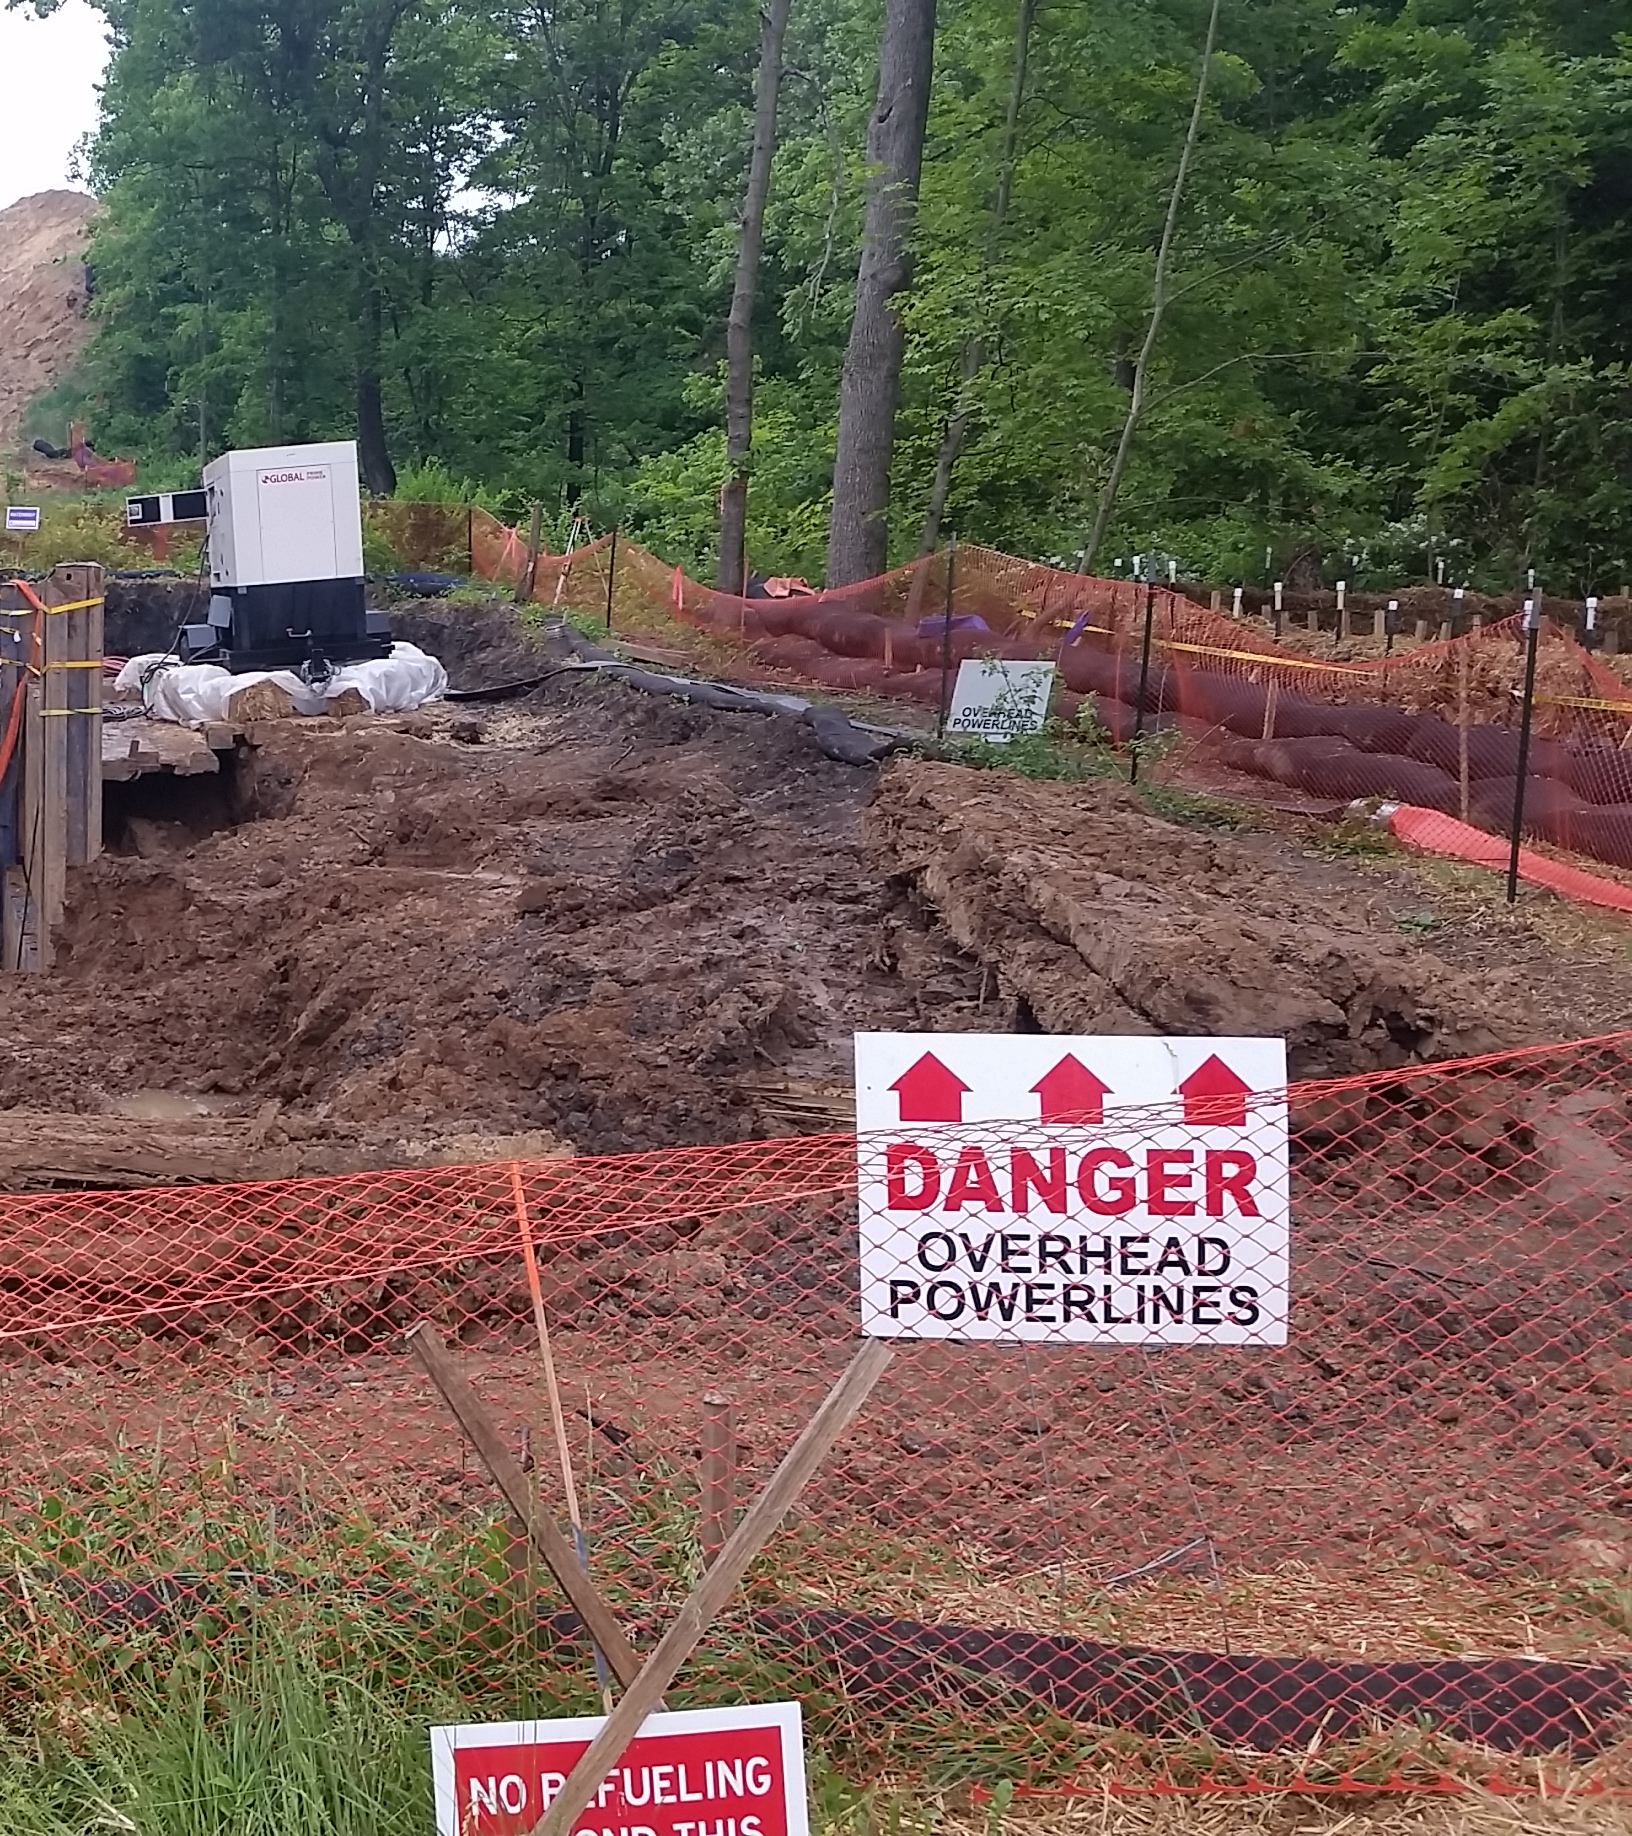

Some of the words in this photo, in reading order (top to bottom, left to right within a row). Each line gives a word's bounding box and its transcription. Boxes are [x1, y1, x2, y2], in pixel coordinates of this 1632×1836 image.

[270, 472, 304, 483] GLOBAL
[952, 718, 1038, 730] POWERLINES
[886, 1142, 1261, 1218] DANGER
[917, 1231, 1231, 1277] OVERHEAD
[888, 1279, 1260, 1326] POWERLINES
[469, 1773, 527, 1816] NO
[540, 1756, 773, 1812] RFUELING
